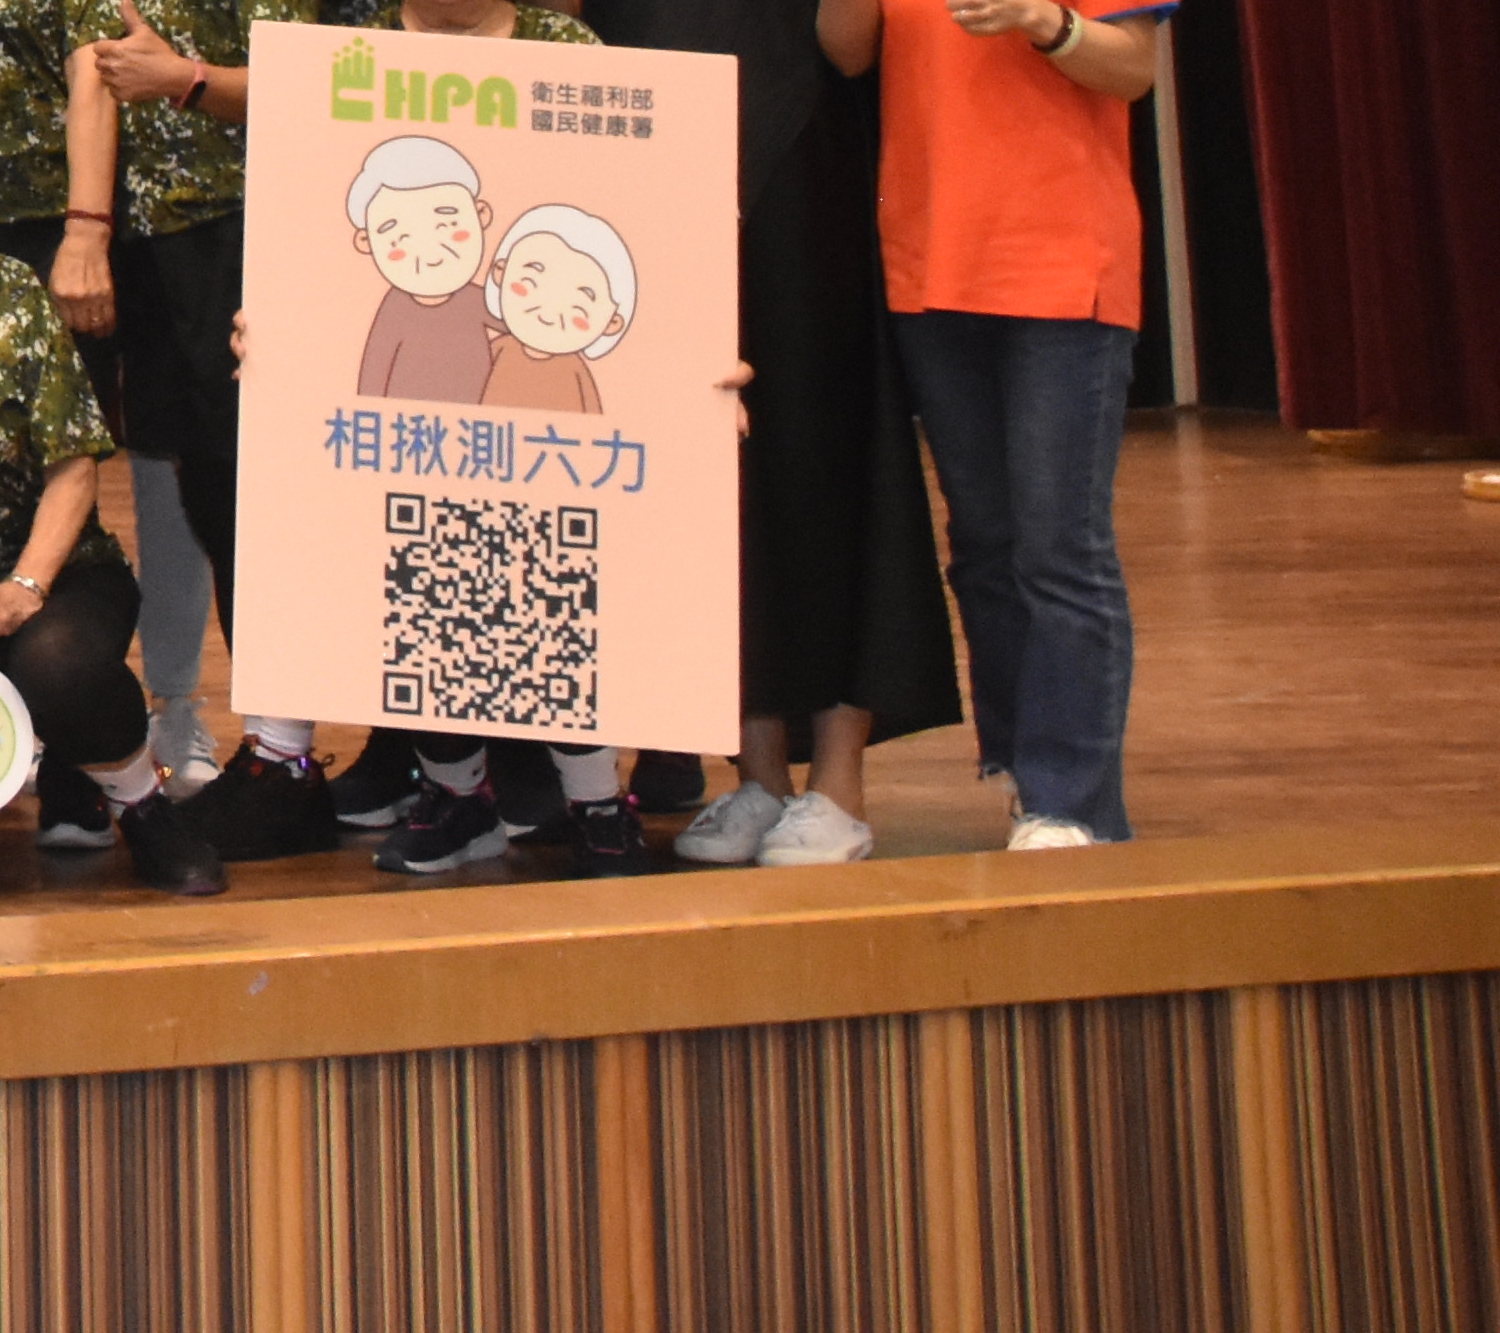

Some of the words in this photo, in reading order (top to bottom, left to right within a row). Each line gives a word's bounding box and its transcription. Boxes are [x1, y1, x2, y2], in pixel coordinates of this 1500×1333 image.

[385, 69, 518, 129] HPA
[531, 81, 655, 111] 衛生福利部
[531, 108, 655, 139] 國民健康署
[323, 406, 648, 494] 相揪測六力
